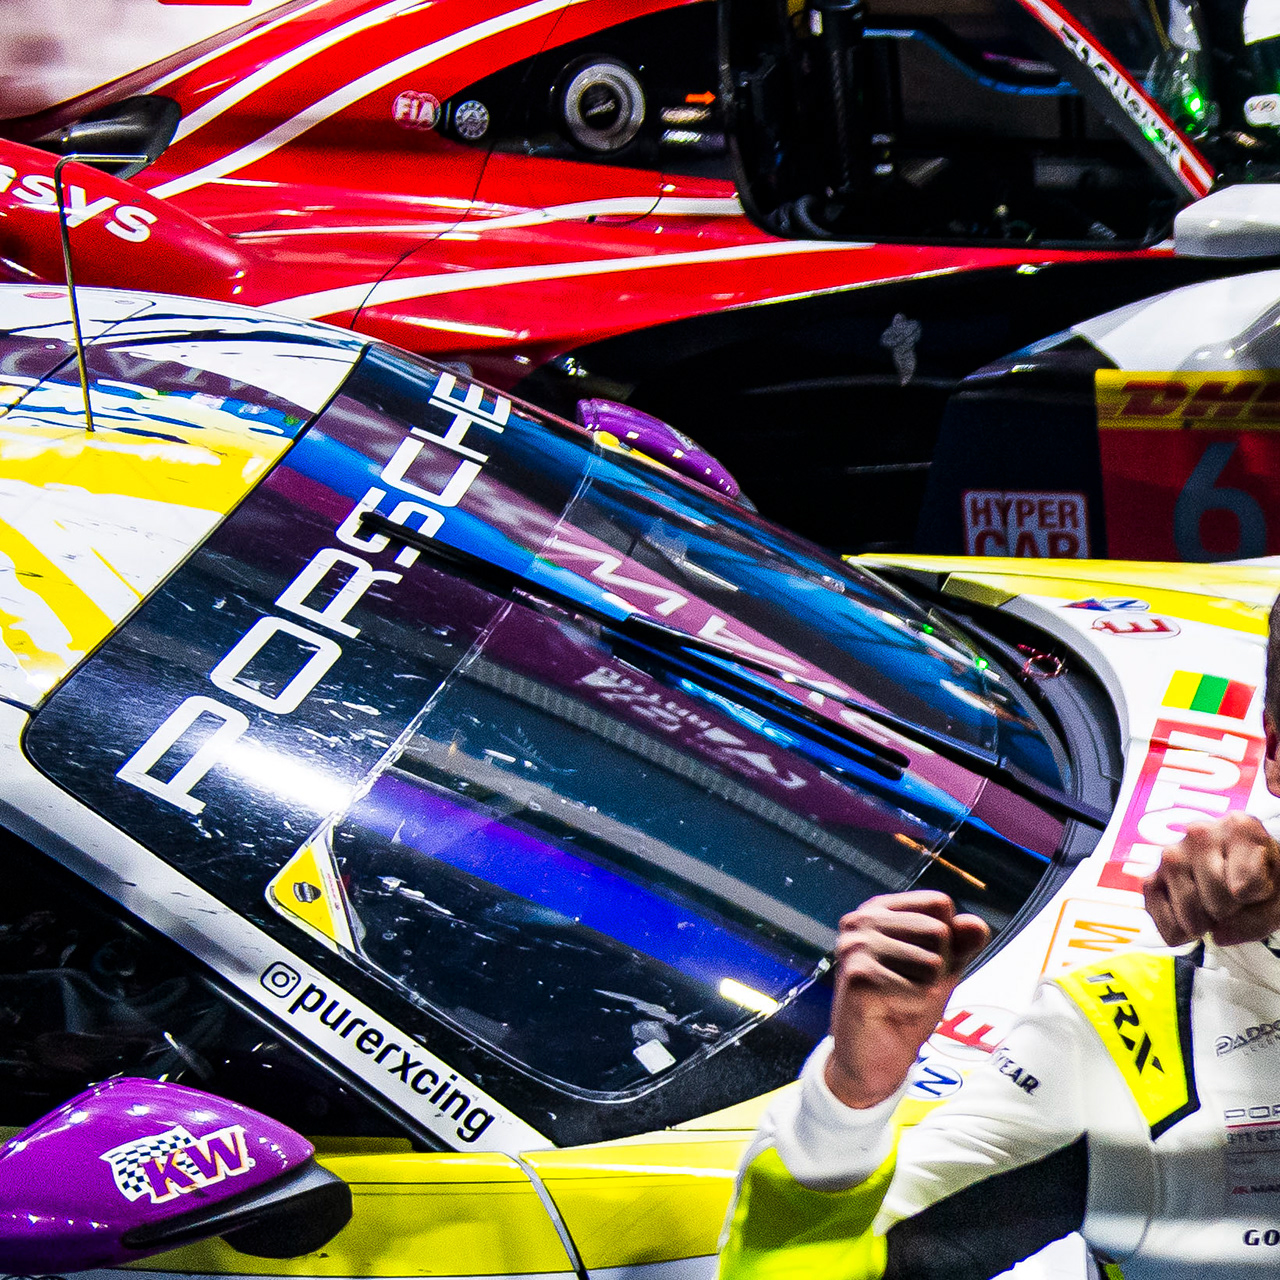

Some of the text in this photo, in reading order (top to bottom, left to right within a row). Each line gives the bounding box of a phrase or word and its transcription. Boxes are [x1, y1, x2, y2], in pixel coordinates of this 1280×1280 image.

[394, 98, 435, 124] FIA
[969, 501, 1080, 530] HYPER
[974, 531, 1080, 558] CAR
[1173, 442, 1267, 560] 6
[116, 372, 511, 815] PORSCHE
[295, 975, 495, 1144] purerxcing
[1086, 970, 1165, 1076] HRX
[145, 1130, 254, 1200] KW
